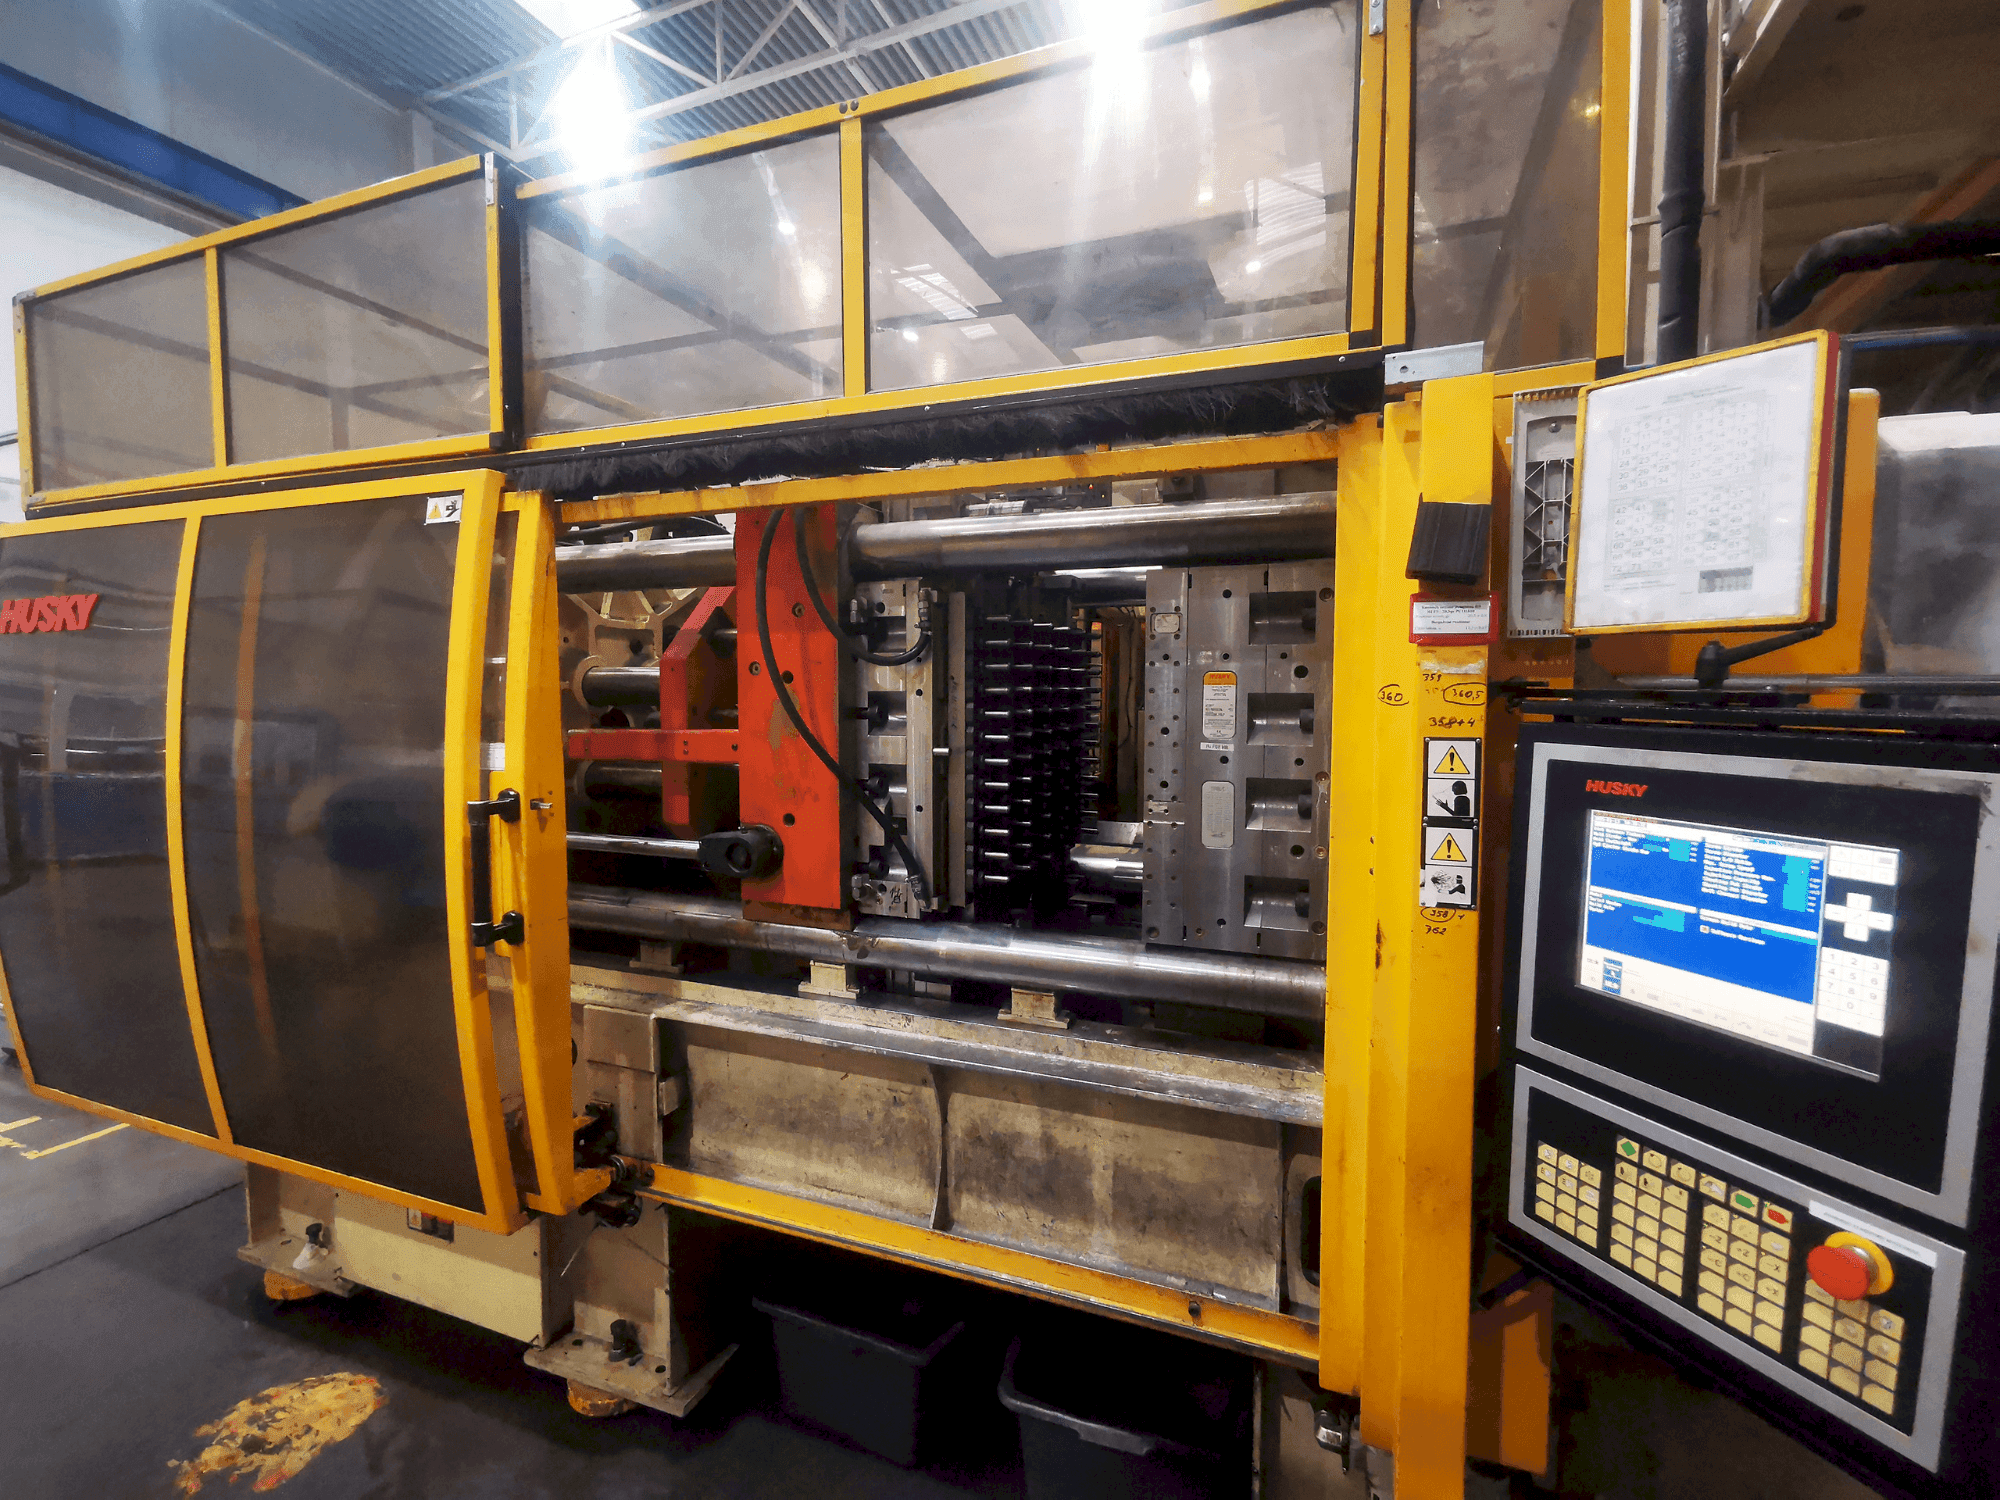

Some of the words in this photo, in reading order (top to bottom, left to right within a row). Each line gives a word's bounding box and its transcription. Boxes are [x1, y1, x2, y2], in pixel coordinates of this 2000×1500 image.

[0, 594, 98, 634] HUSKY
[1380, 690, 1403, 702] 360
[1586, 779, 1648, 798] HUSKY
[1430, 909, 1448, 918] 358
[1850, 958, 1858, 966] 2
[1872, 962, 1880, 970] 3
[1828, 968, 1836, 976] 4
[1849, 972, 1856, 980] 5
[1870, 977, 1878, 986] 6
[1847, 986, 1855, 995] 8
[1869, 992, 1878, 1000] 9
[1846, 1001, 1854, 1010] 0
